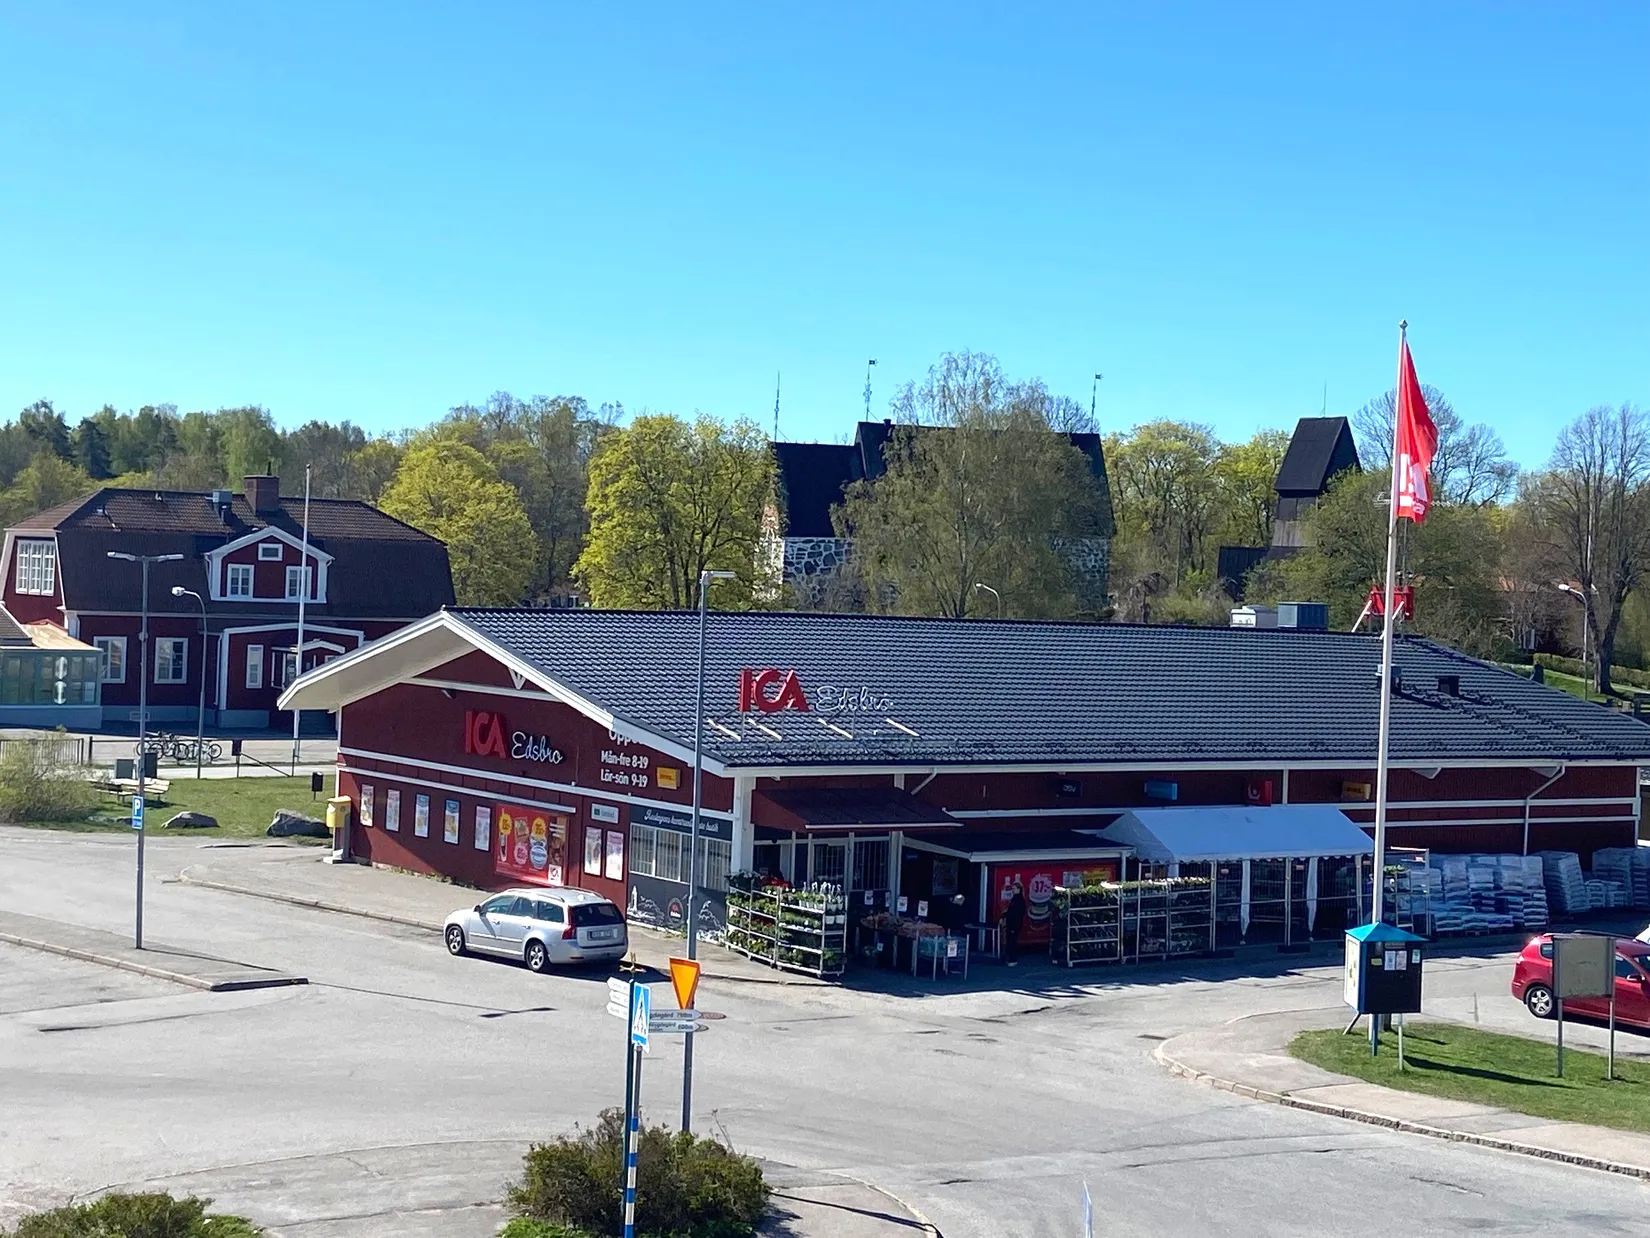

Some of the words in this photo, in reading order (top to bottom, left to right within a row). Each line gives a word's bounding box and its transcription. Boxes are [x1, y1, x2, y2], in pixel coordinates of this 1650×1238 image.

[737, 668, 811, 713] ICA
[815, 685, 893, 713] Edsbro
[465, 711, 508, 759] ICA
[511, 731, 563, 765] Edsbro
[601, 750, 631, 767] Mån-fre
[631, 754, 649, 769] 8-19
[600, 768, 629, 785] Lör-sön
[631, 773, 648, 788] 9-19
[134, 799, 141, 816] P
